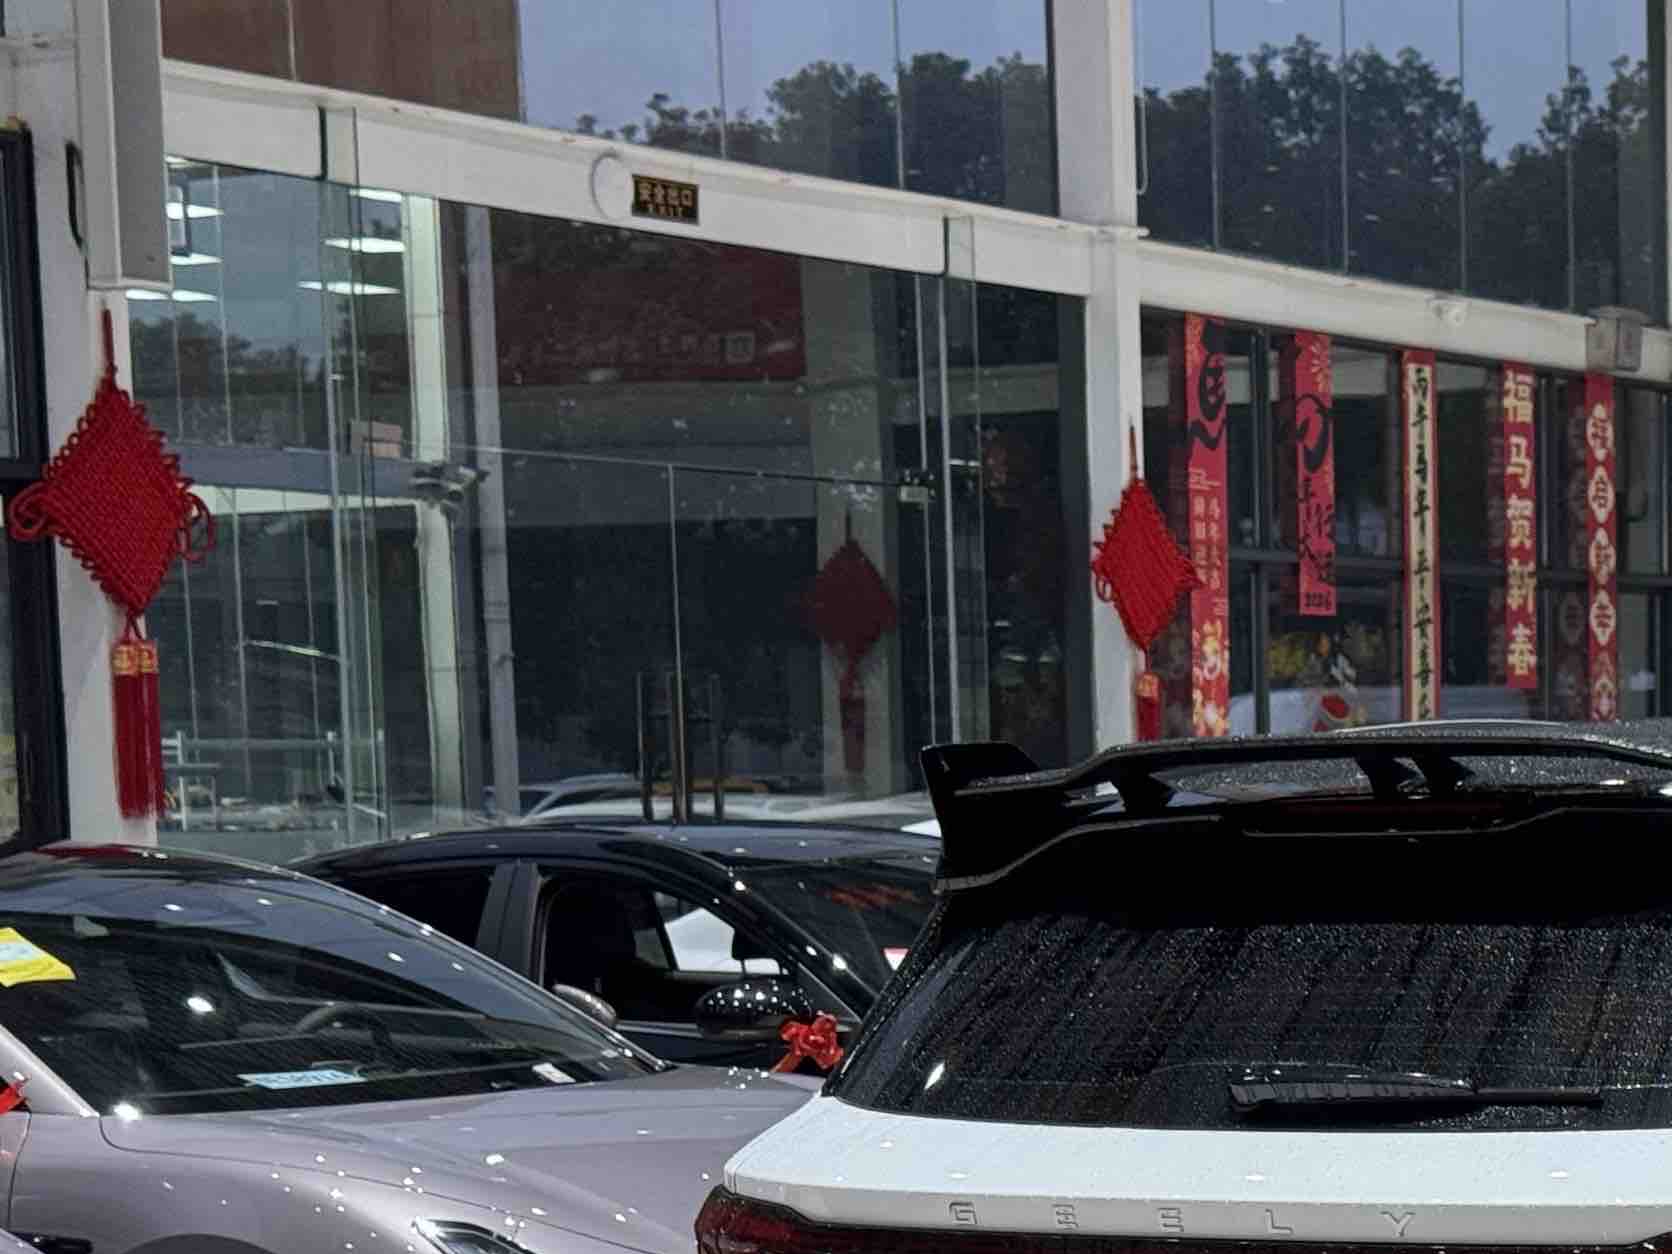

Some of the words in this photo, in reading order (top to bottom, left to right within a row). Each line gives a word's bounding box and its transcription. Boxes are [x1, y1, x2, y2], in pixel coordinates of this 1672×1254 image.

[1503, 369, 1536, 677] 福马贺新春
[948, 1202, 1416, 1237] GEELY
